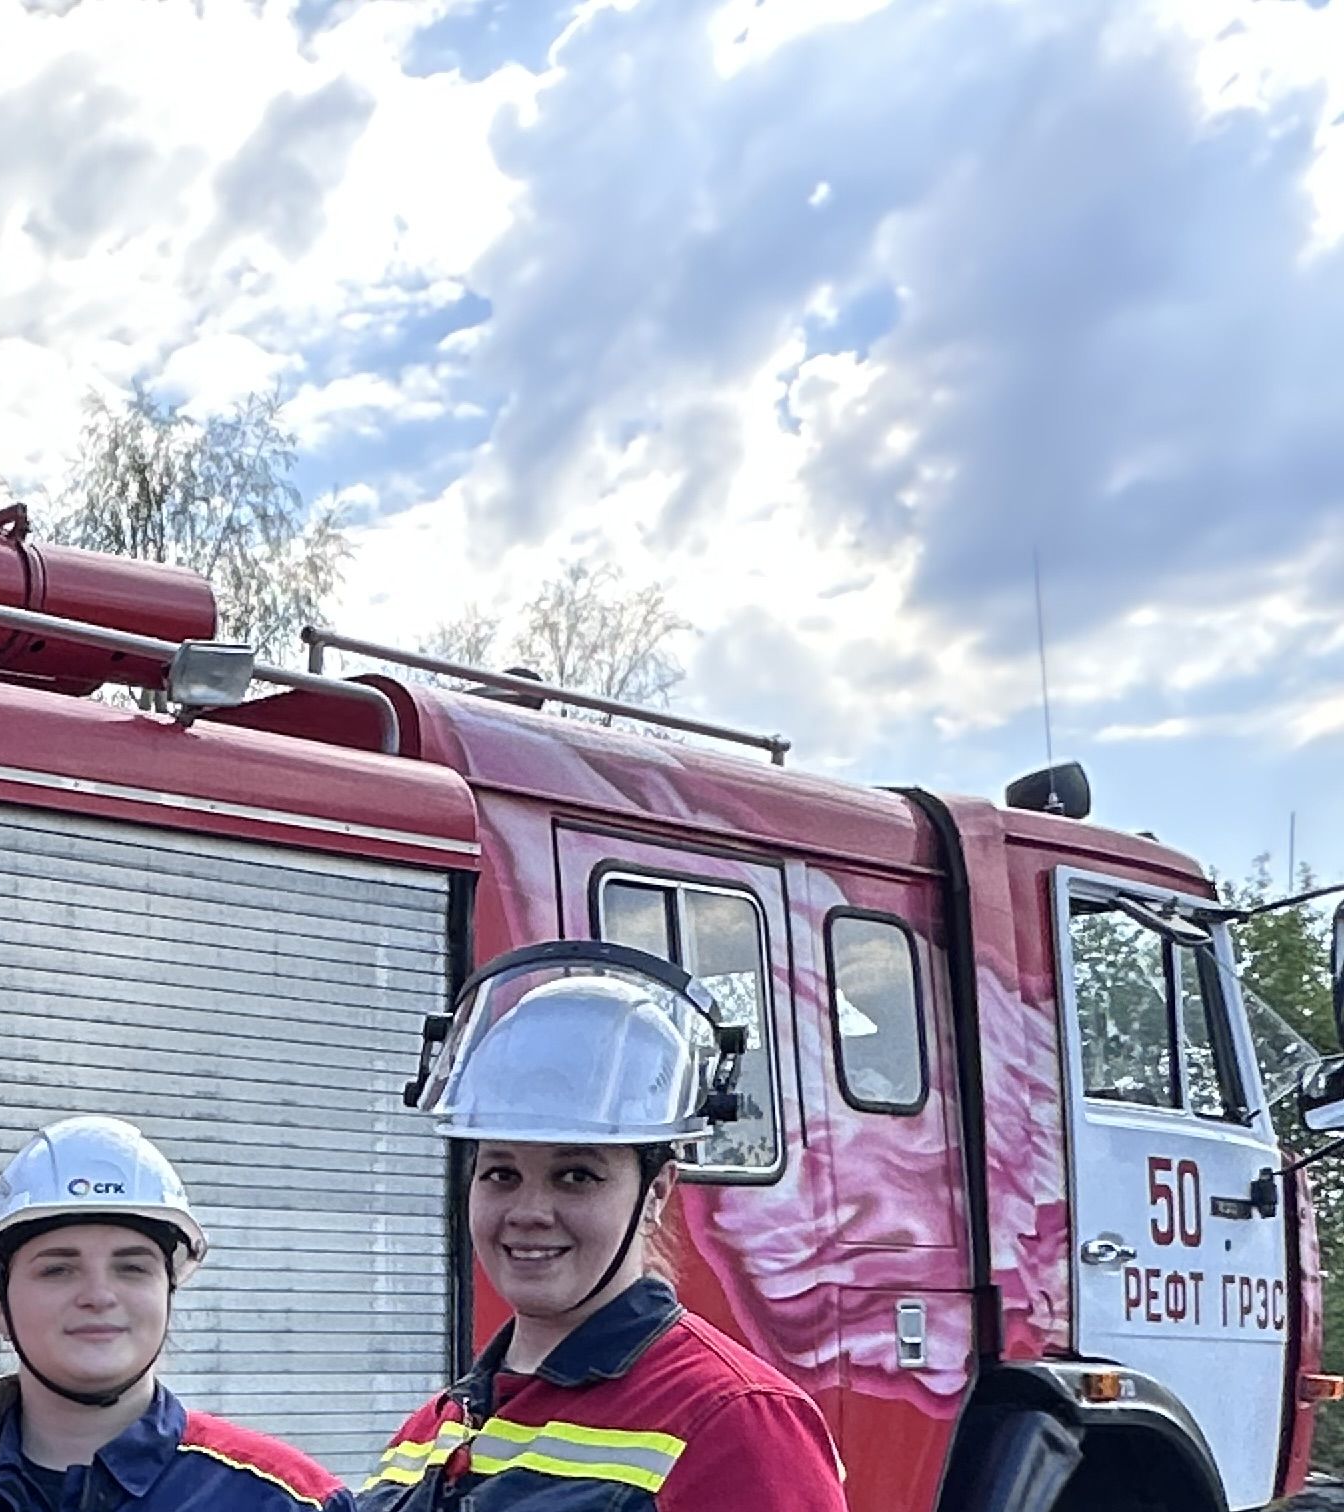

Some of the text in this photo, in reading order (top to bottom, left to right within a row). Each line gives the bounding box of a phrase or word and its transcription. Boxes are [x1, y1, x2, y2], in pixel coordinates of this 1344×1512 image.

[93, 1182, 125, 1194] СГК
[1148, 1156, 1201, 1248] 50
[1124, 1266, 1204, 1326] РЕФТ
